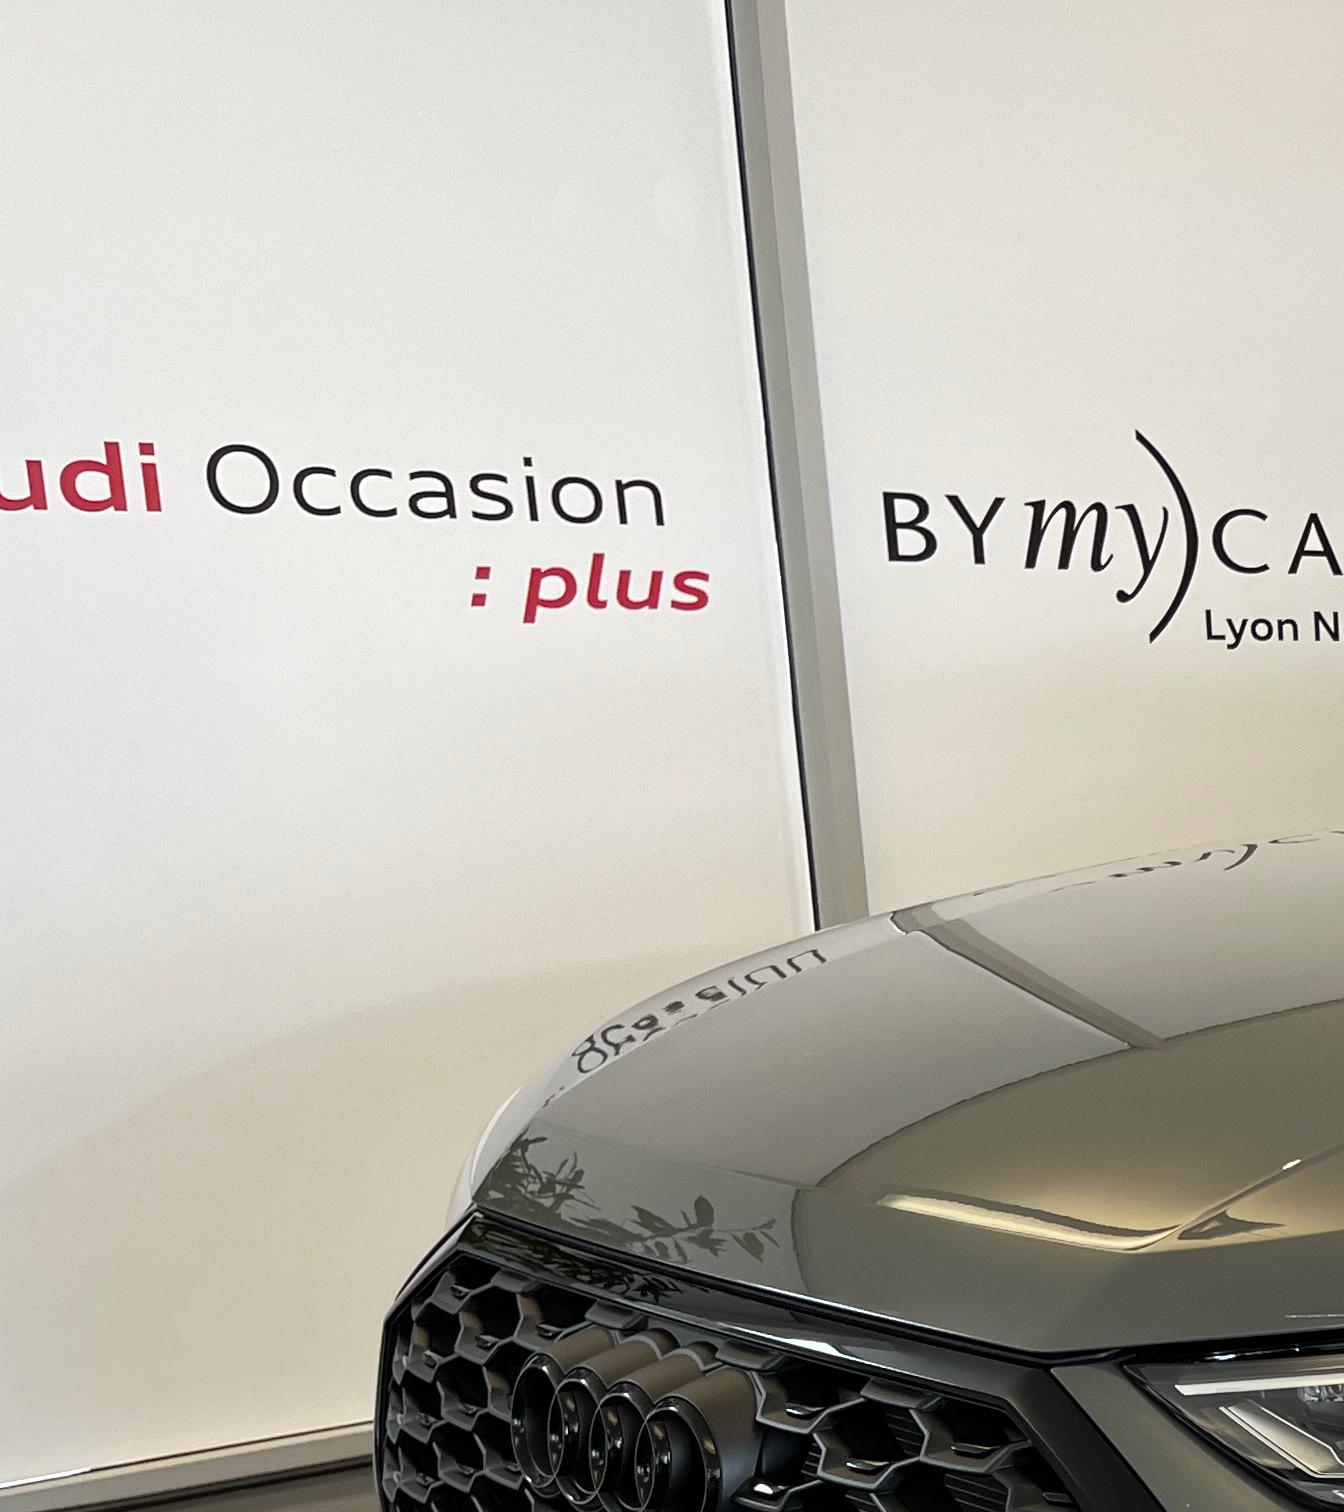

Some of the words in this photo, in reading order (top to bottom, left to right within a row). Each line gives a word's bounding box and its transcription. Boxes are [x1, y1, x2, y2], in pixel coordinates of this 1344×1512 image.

[0, 441, 163, 512] udi
[206, 444, 665, 527] Occasion
[1205, 609, 1299, 649] Lyon
